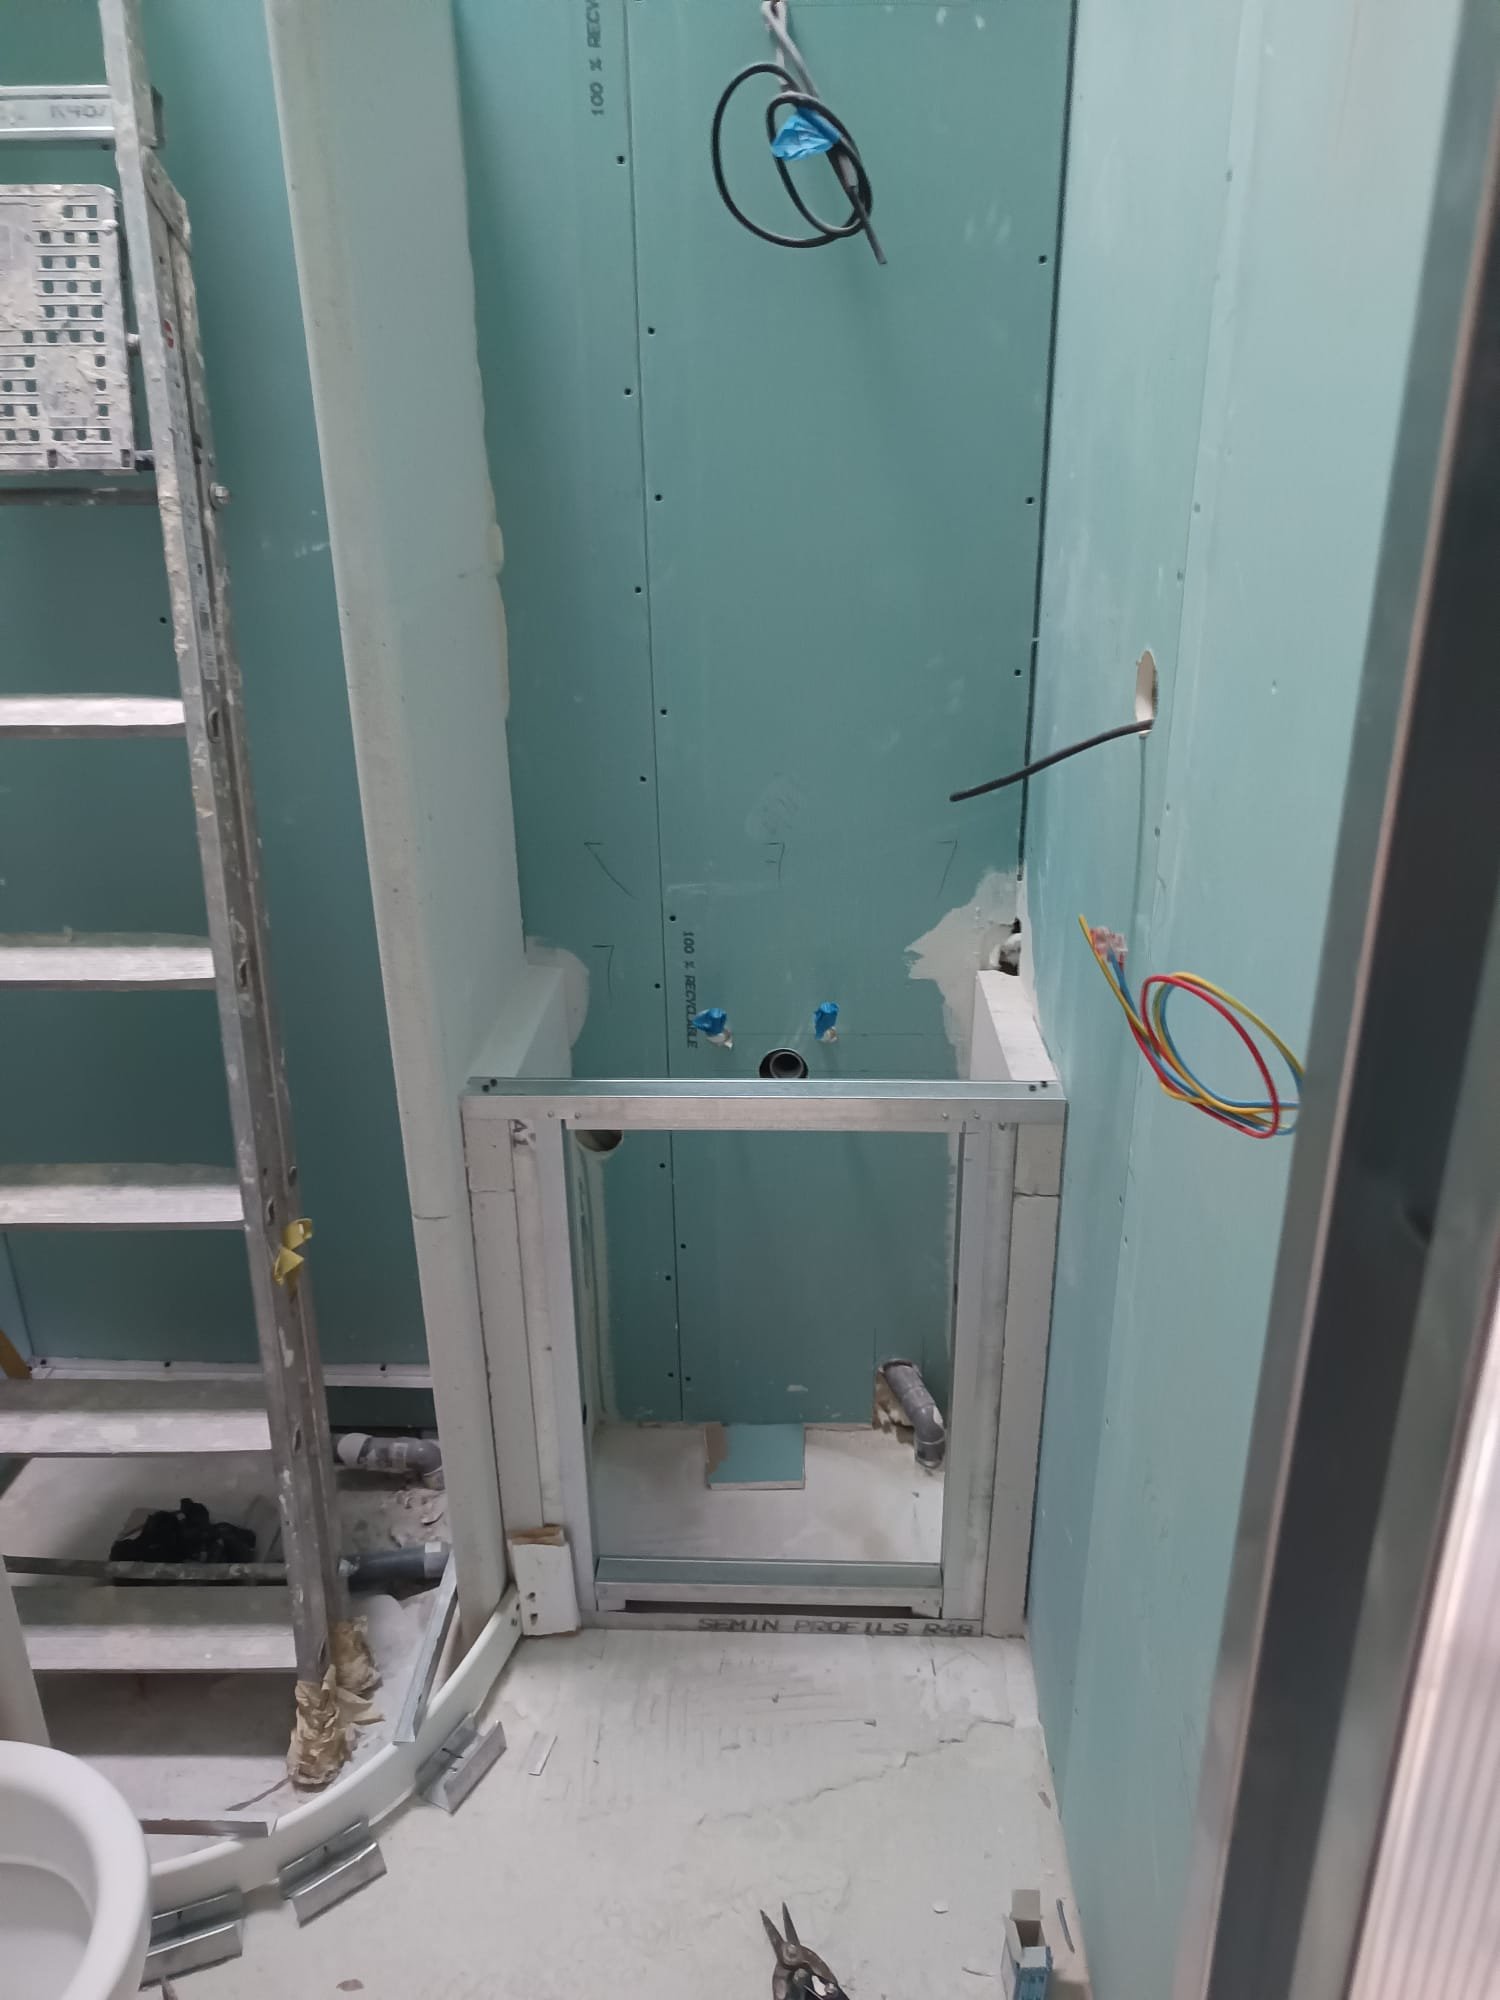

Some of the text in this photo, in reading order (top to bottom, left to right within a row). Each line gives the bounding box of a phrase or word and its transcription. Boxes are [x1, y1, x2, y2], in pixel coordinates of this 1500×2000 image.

[588, 57, 602, 72] %
[589, 82, 604, 116] 100
[683, 931, 695, 954] 100
[697, 1617, 780, 1633] SEMIN
[793, 1619, 910, 1636] PROFILS
